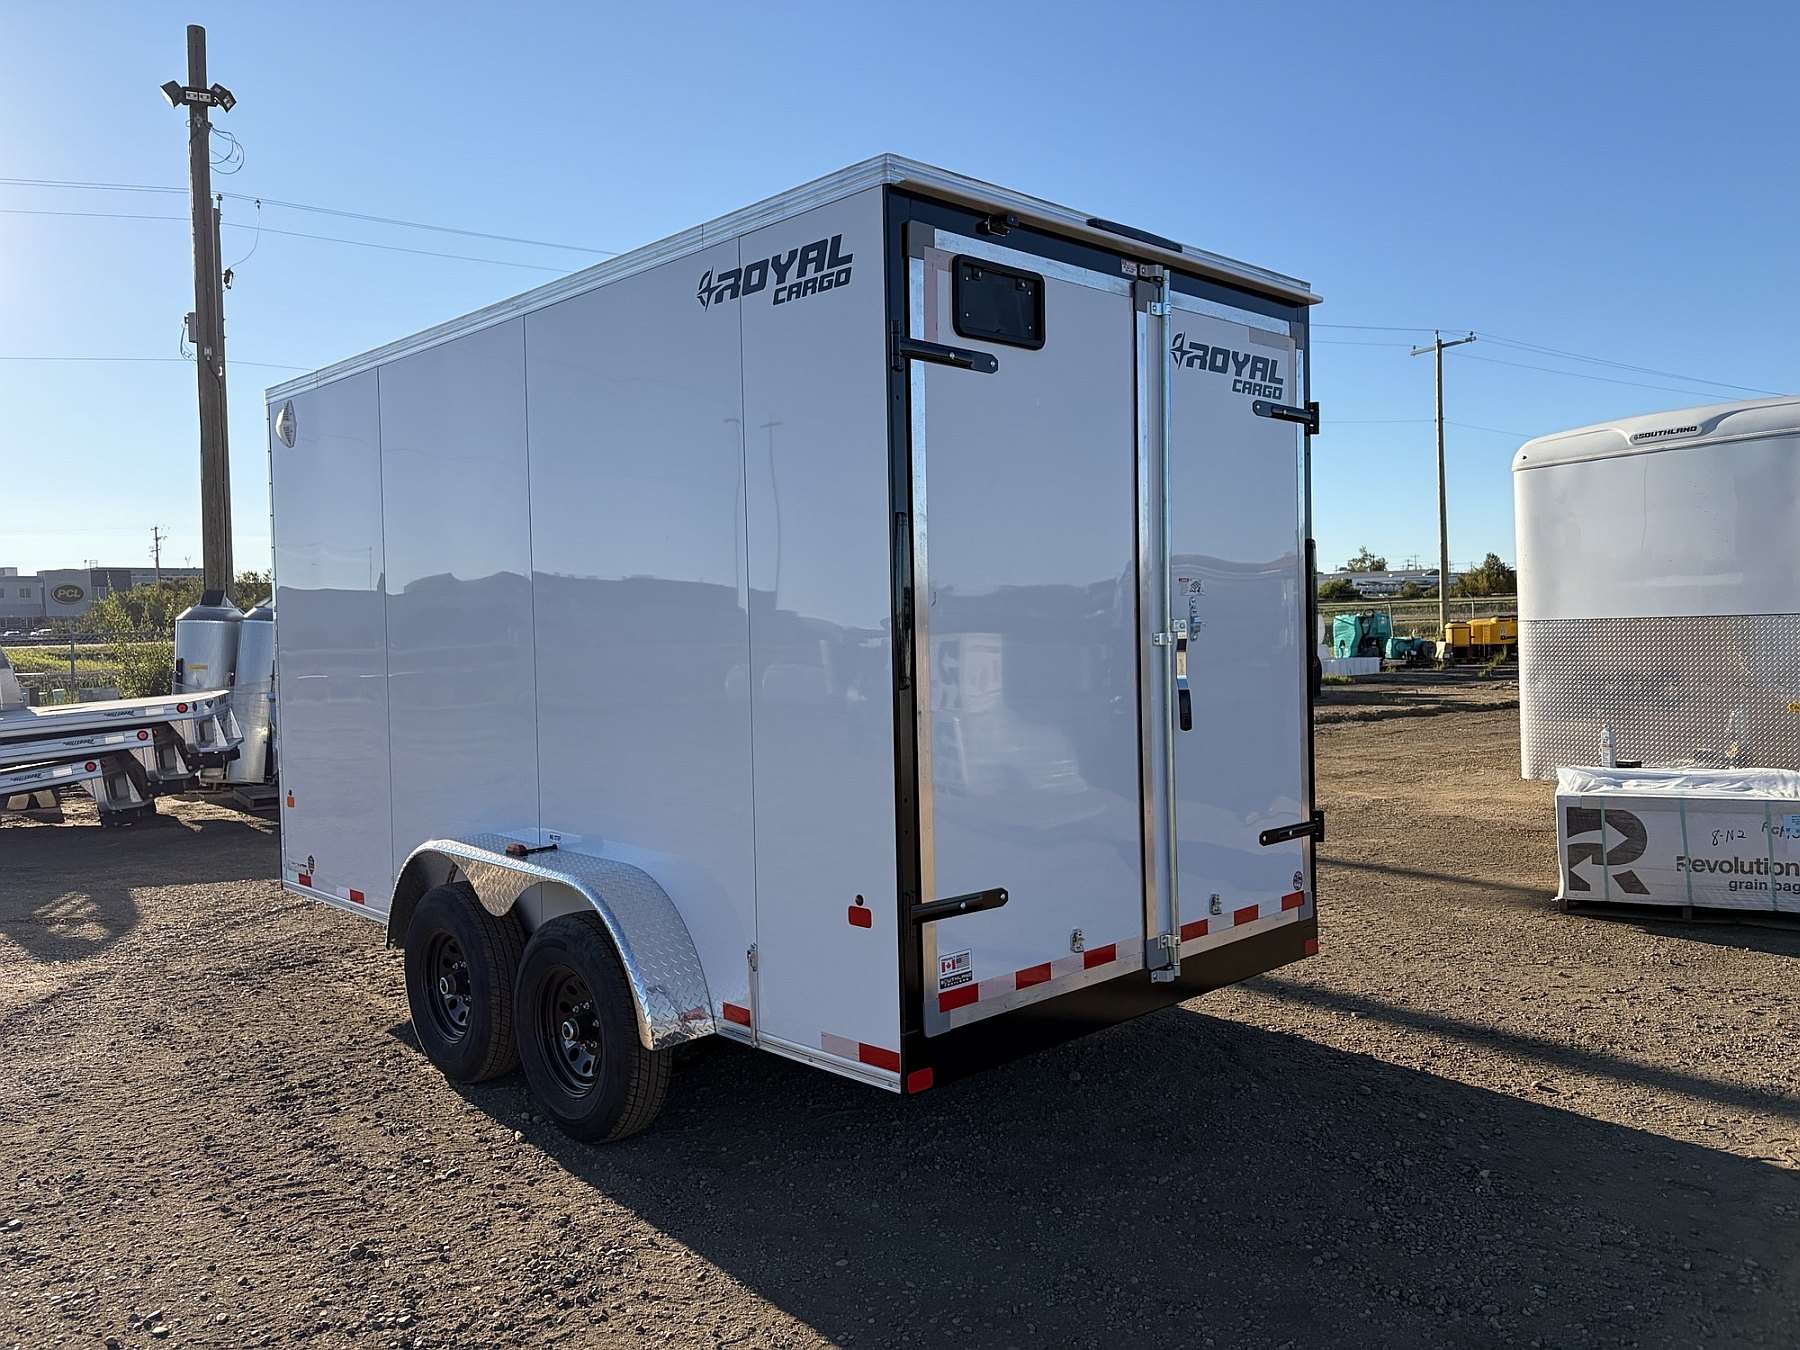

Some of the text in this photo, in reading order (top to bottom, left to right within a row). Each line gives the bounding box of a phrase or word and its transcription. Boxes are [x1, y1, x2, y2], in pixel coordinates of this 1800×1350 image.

[714, 234, 853, 304] ROYAL
[773, 267, 852, 305] CARGO
[1186, 341, 1283, 385] ROYAL
[1232, 378, 1282, 400] CARGO
[1639, 426, 1697, 439] SOUTHLAND
[57, 589, 80, 598] PCL
[1676, 855, 1800, 877] Revolution
[1729, 879, 1767, 892] grain
